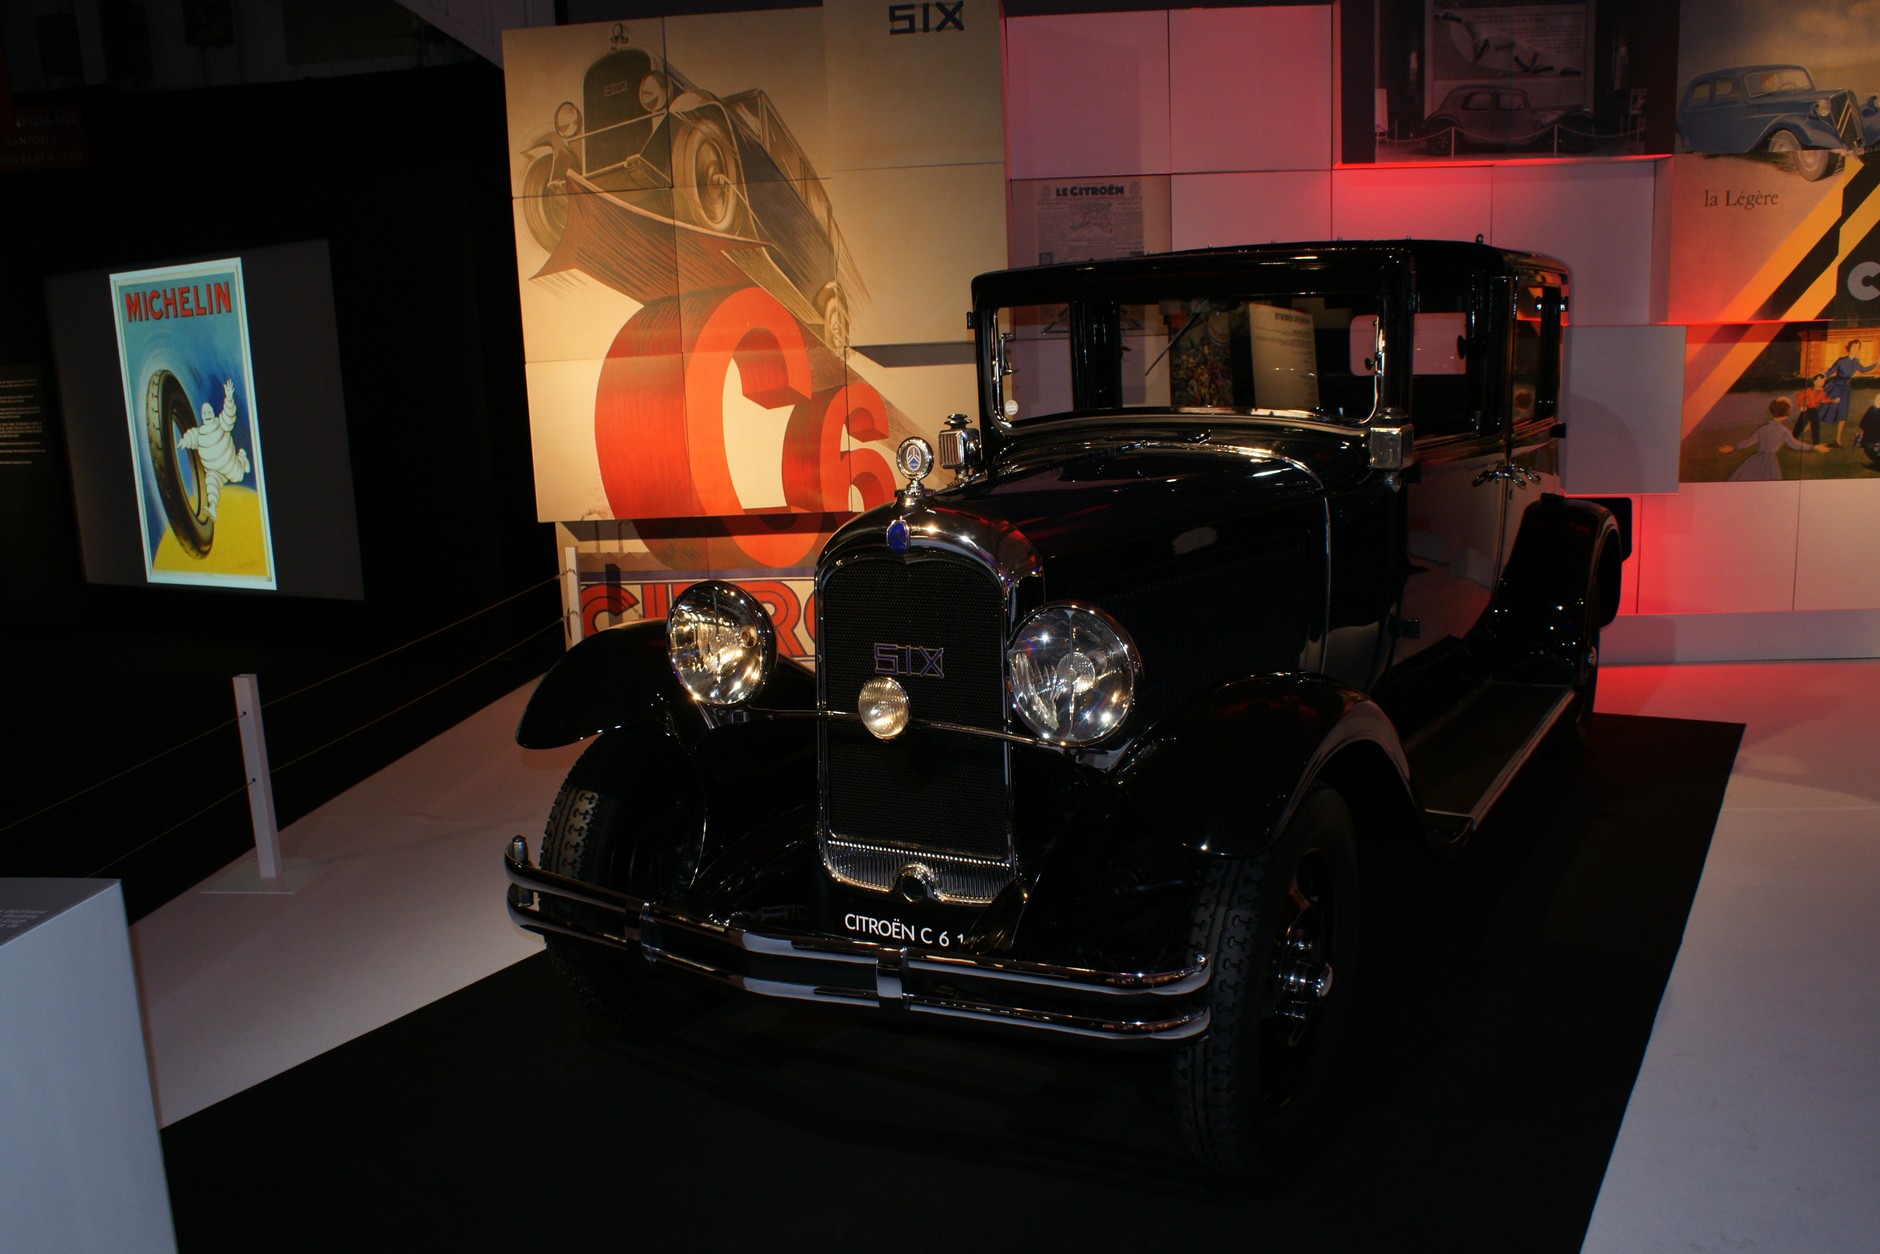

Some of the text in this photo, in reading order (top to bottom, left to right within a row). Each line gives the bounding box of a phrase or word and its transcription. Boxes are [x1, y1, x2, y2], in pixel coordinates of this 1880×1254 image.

[889, 1, 964, 35] SIX
[1056, 184, 1125, 197] LE CITROËN
[1704, 189, 1779, 210] la Légère
[125, 281, 232, 322] MICHELIN
[874, 643, 944, 678] SIX
[844, 913, 915, 942] CITROËN
[920, 927, 933, 944] C
[939, 931, 950, 947] 6
